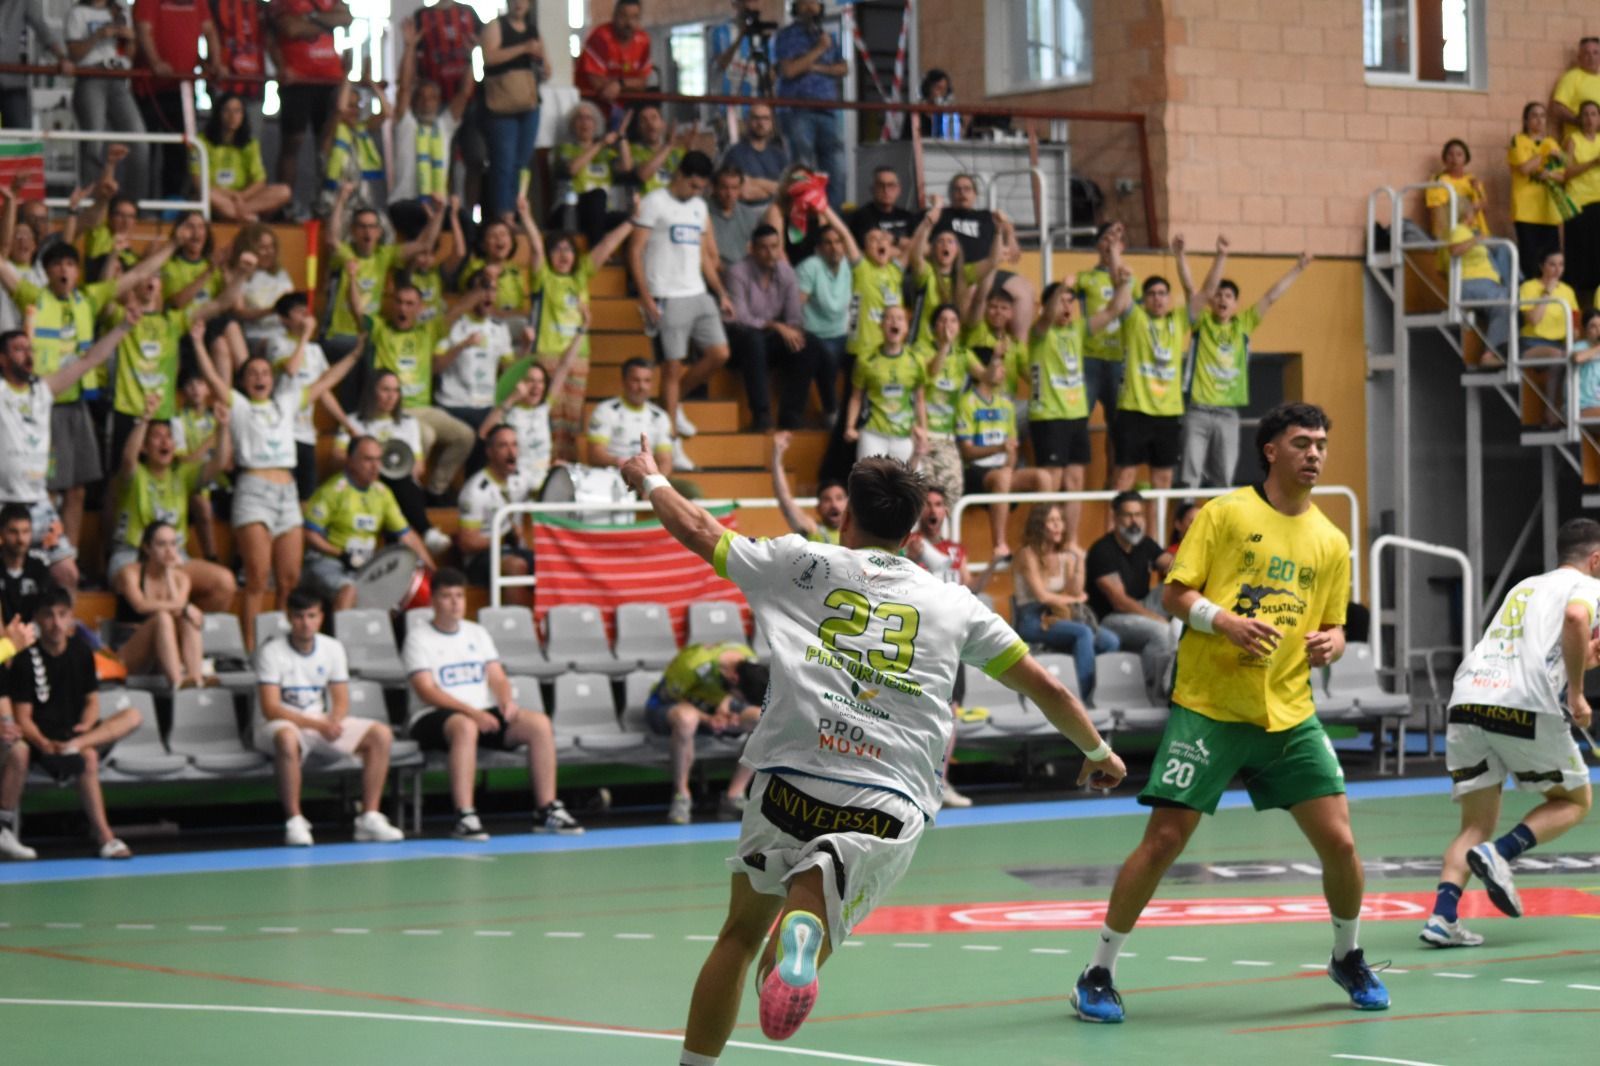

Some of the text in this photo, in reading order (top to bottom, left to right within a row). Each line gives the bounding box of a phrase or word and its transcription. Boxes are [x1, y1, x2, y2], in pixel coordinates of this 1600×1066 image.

[1267, 555, 1296, 582] 20
[1501, 587, 1535, 627] 6
[818, 588, 920, 673] 23
[805, 645, 844, 670] PAU
[818, 718, 864, 743] PRO
[1161, 757, 1196, 789] 20
